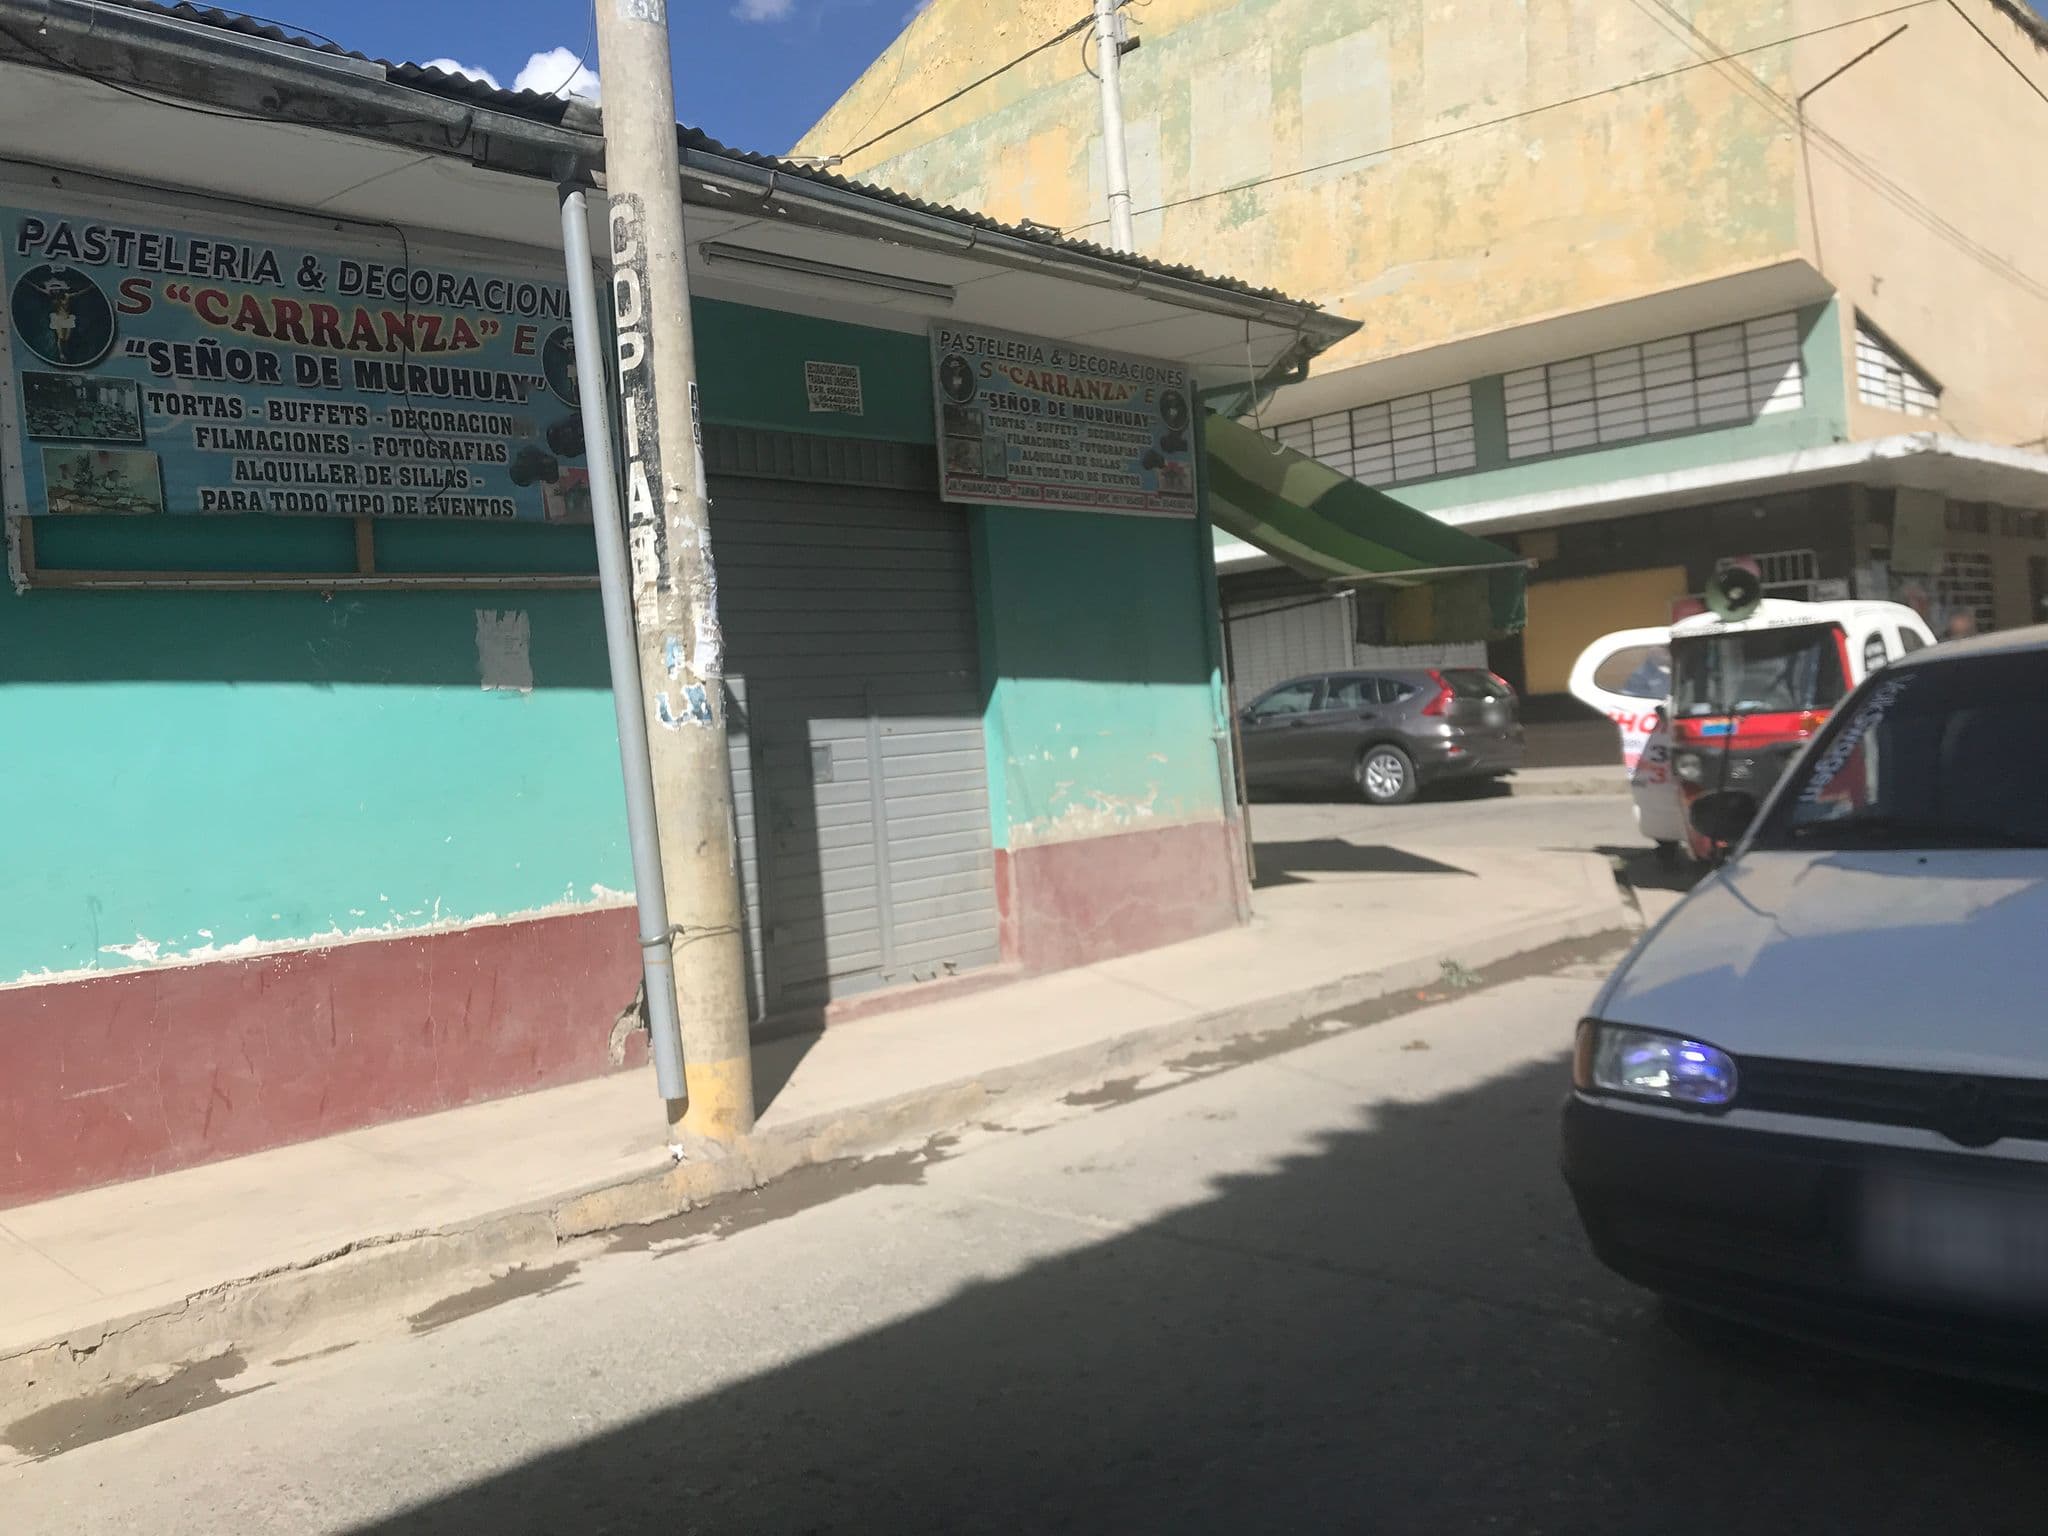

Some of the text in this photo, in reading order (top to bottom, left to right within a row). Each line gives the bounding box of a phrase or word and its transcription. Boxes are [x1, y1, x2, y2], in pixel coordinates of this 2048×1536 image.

[17, 217, 282, 284] PASTELERIA
[297, 255, 324, 289] &
[117, 278, 153, 314] S
[514, 325, 538, 356] E
[295, 353, 338, 387] DE
[940, 330, 1183, 385] PASTELERIA & DECORACIONES
[148, 392, 242, 419] TORTAS
[268, 401, 368, 427] BUFFETS
[1048, 401, 1066, 416] DE
[989, 416, 1026, 430] TORTAS
[1036, 422, 1078, 437] BUFFETS
[196, 427, 349, 455] FILMACIONES
[373, 438, 507, 463] FOTOGRAFIAS
[234, 459, 358, 485] ALQUILLER
[365, 467, 391, 486] DE
[400, 467, 469, 490] SILLAS
[201, 491, 515, 519] PARA TODO TIPO DE EVENTOS
